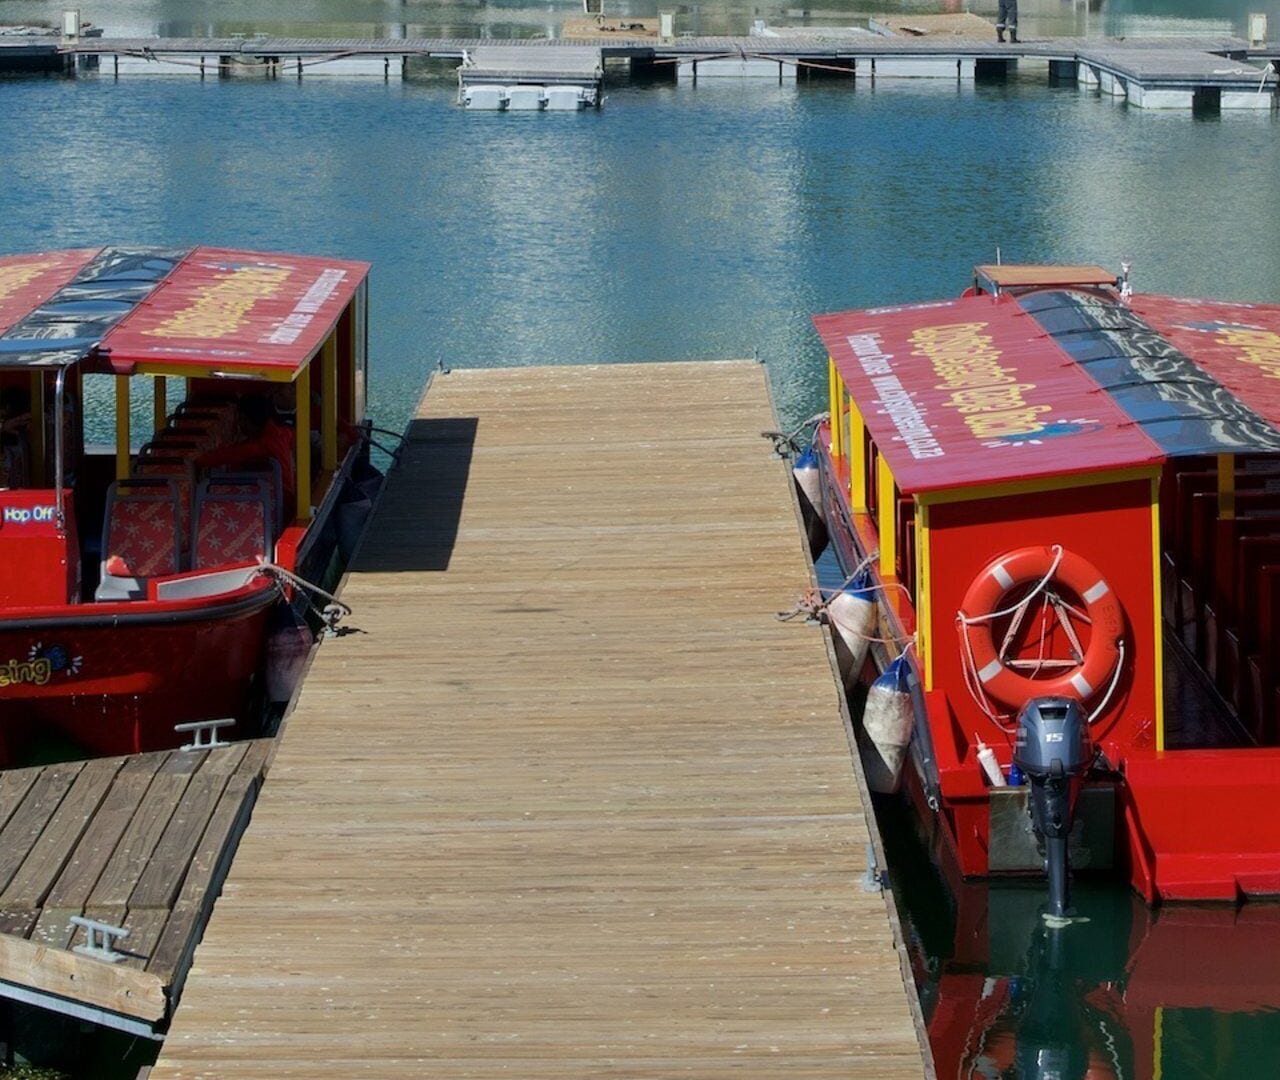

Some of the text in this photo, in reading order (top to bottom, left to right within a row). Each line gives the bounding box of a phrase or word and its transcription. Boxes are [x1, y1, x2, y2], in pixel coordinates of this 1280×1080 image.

[4, 508, 30, 523] Hop
[32, 506, 54, 521] Off
[1045, 732, 1064, 743] 15
